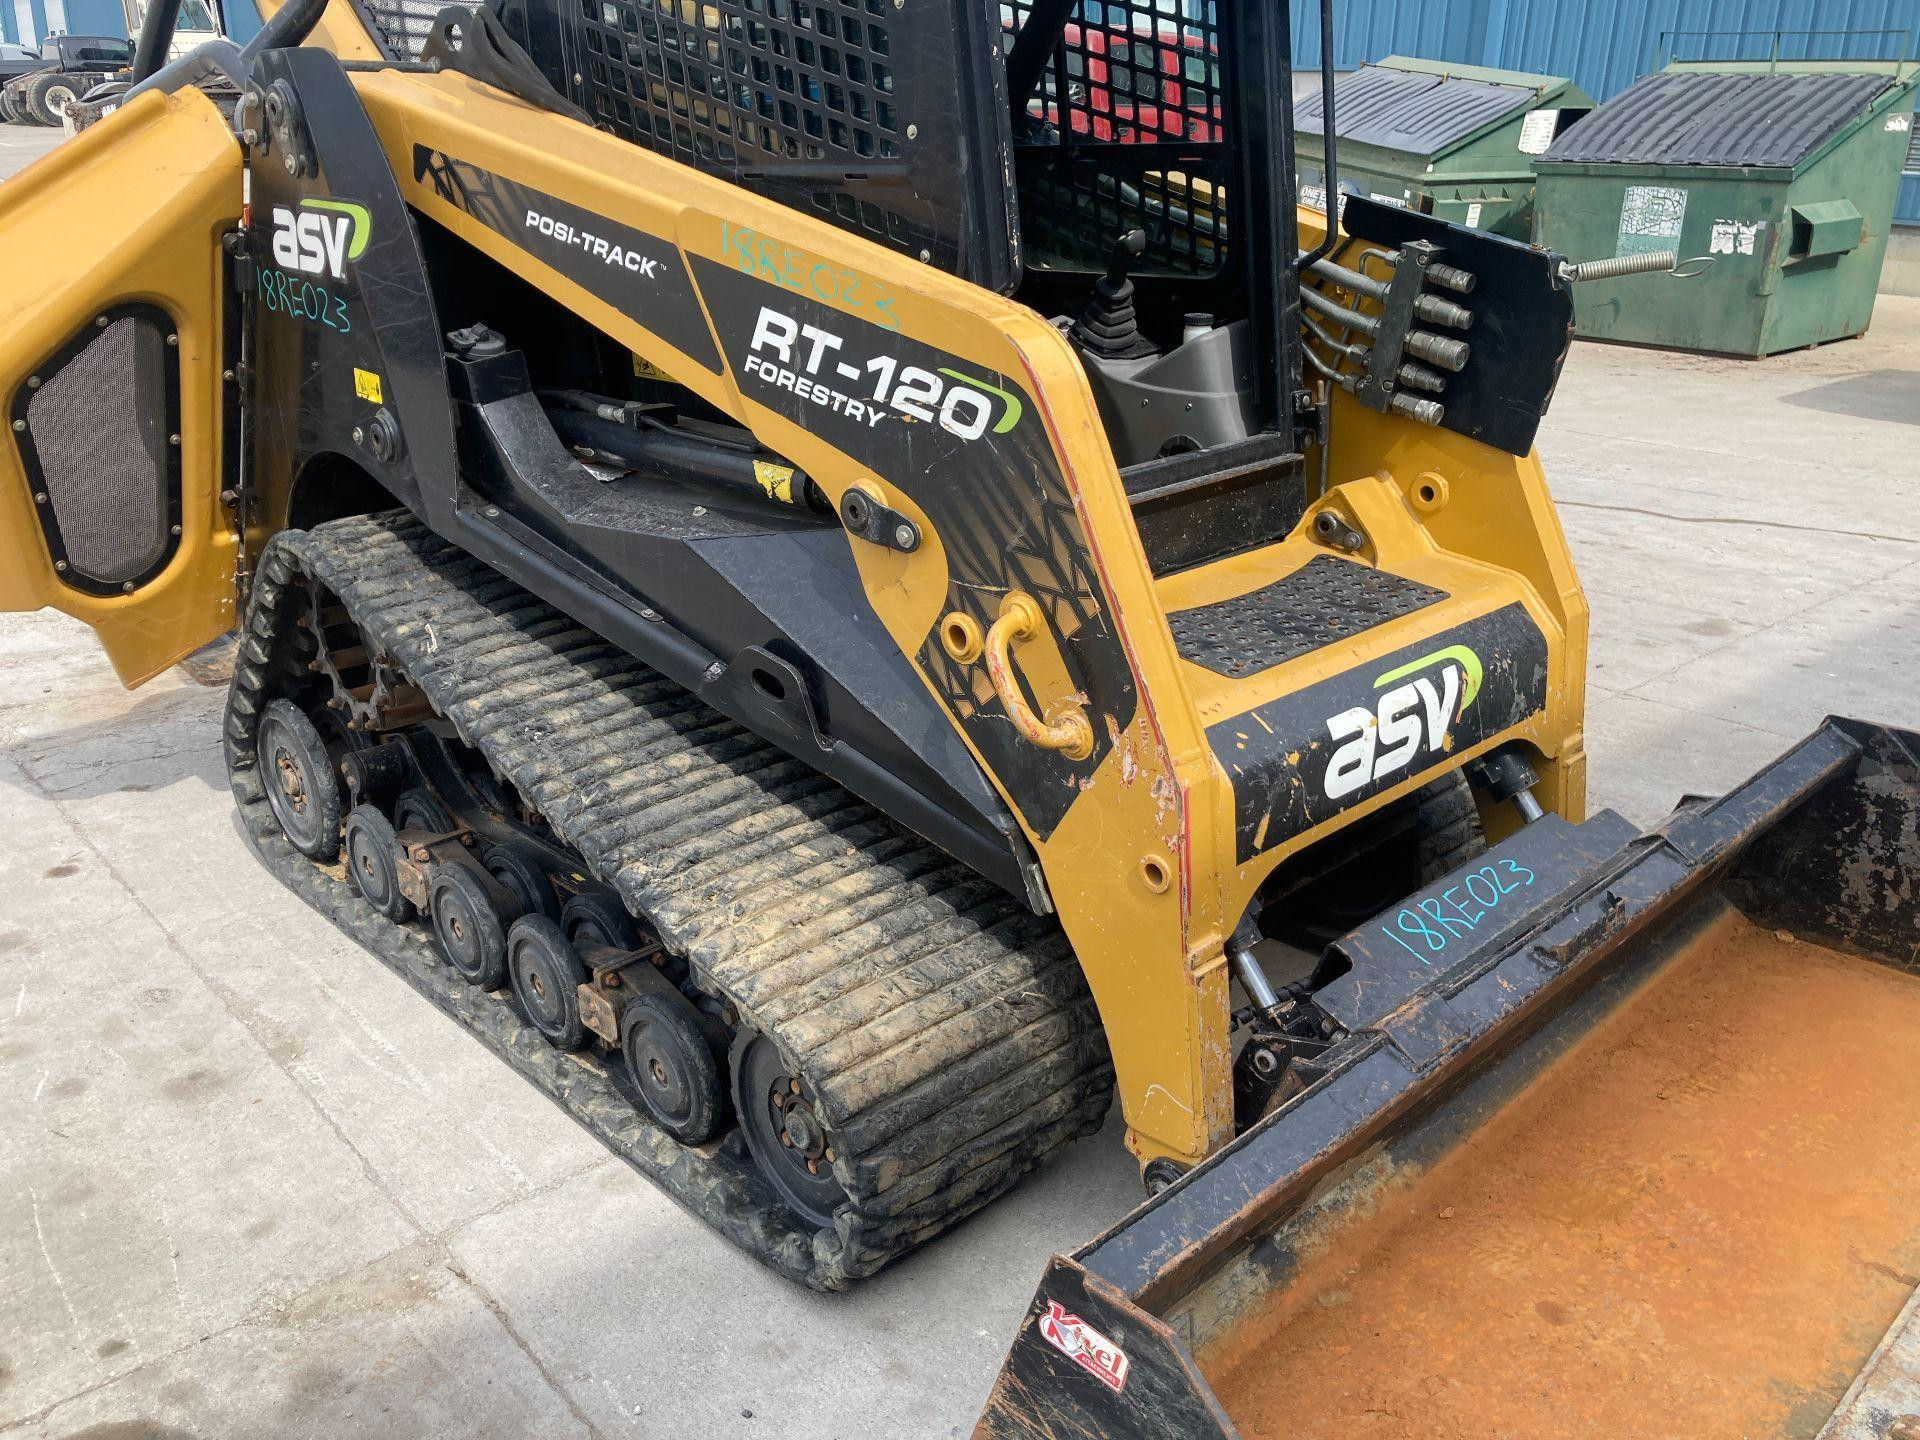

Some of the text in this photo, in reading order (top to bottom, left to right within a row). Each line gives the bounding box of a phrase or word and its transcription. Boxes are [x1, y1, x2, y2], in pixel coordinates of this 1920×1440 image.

[525, 209, 658, 279] POSI-TRACK
[721, 216, 900, 332] 18RE023
[256, 265, 351, 333] 18RE023
[743, 354, 887, 428] FORESTRY
[750, 306, 993, 441] RT-120
[1381, 859, 1535, 965] 18RE023
